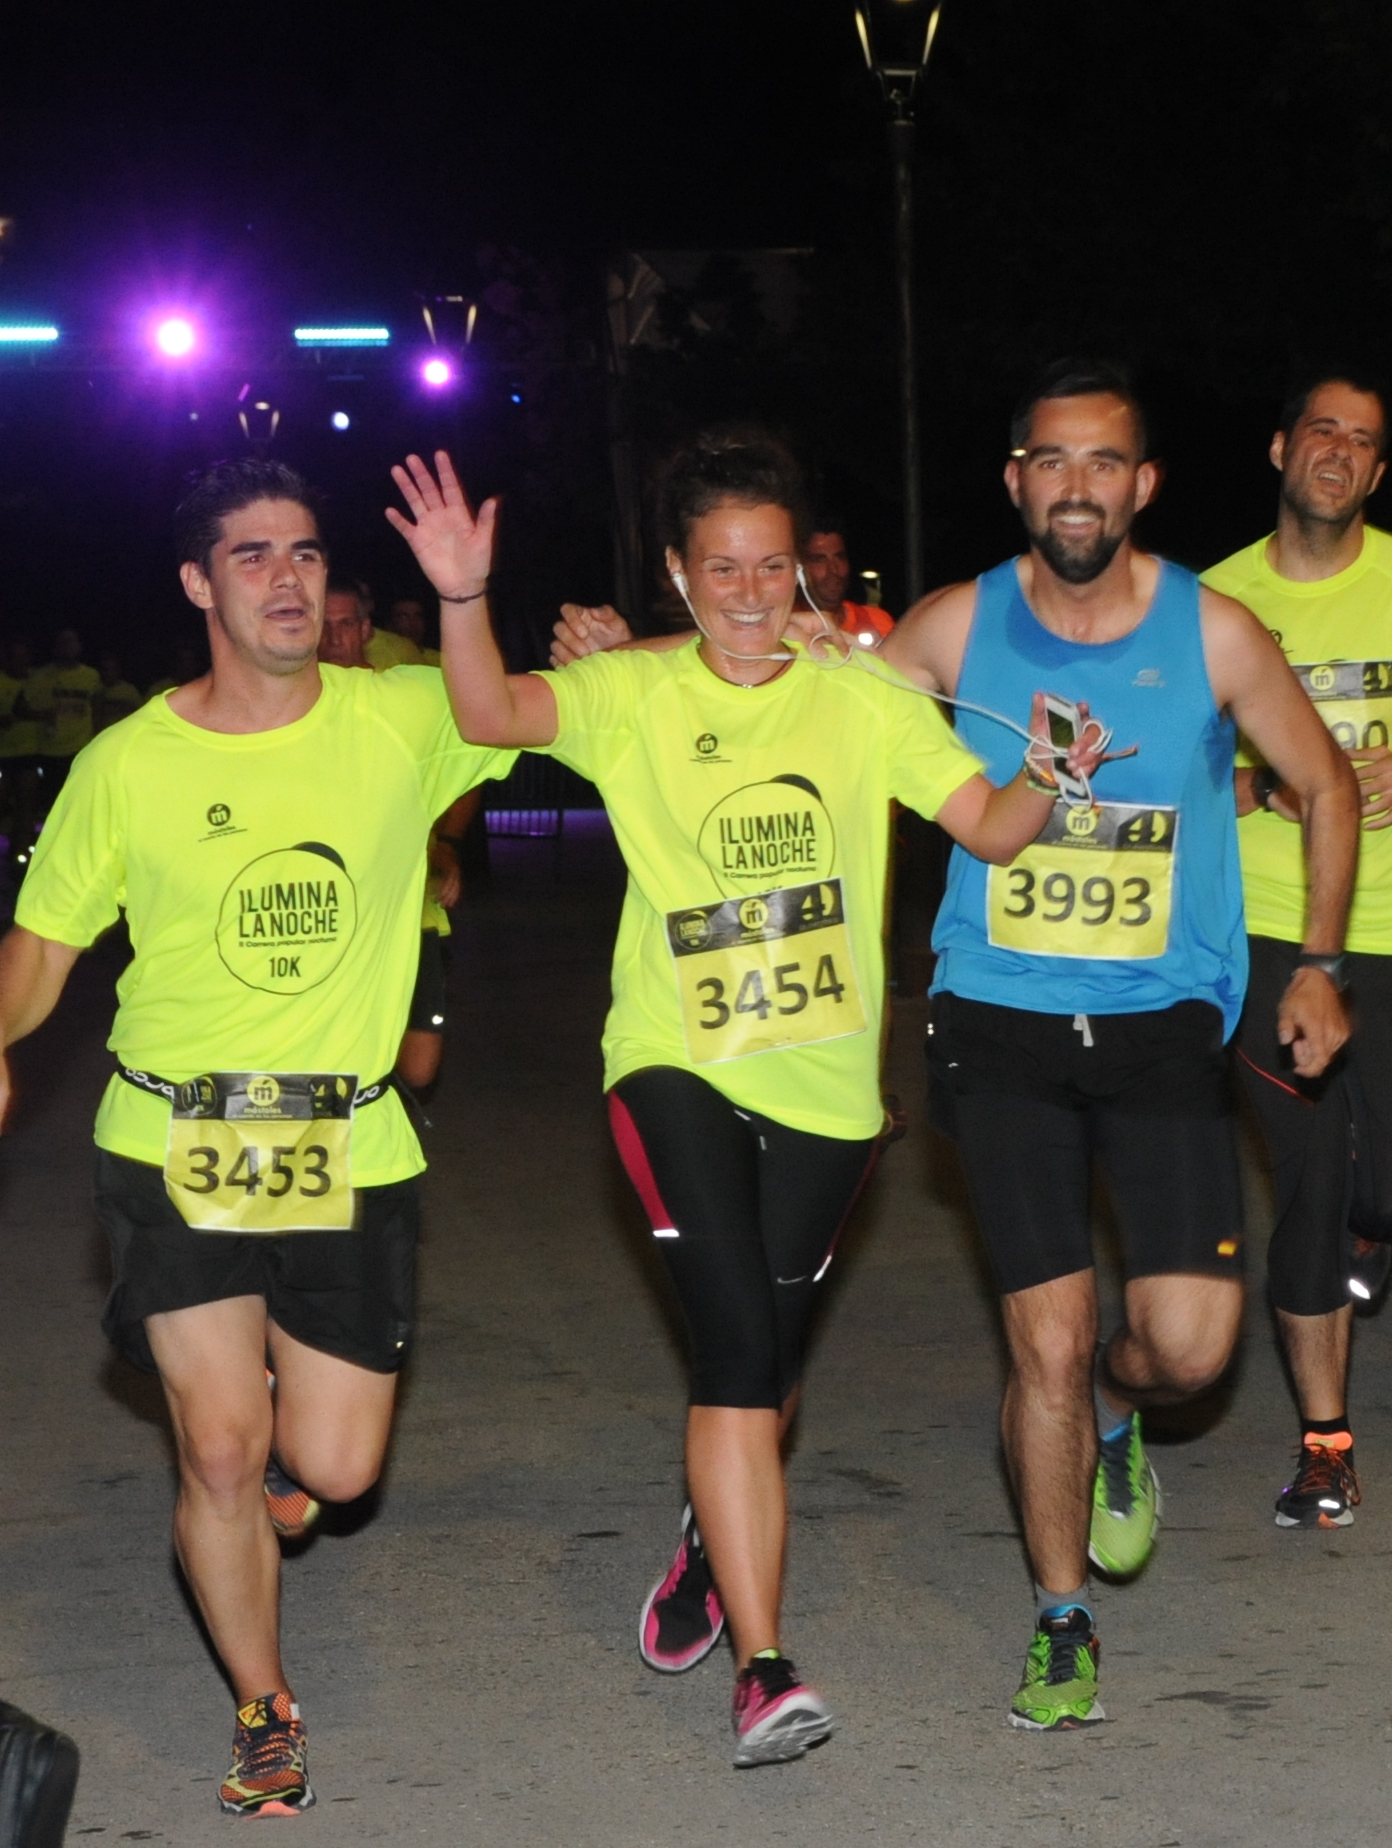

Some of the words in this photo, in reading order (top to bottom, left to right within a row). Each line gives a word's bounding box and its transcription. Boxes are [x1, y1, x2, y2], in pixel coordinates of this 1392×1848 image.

[1330, 720, 1389, 750] 90
[719, 811, 816, 844] ILUMINA
[239, 880, 339, 915] ILUMINA
[1004, 868, 1152, 927] 3993
[269, 956, 301, 977] 10K
[696, 954, 845, 1030] 3454
[182, 1145, 332, 1198] 3453
